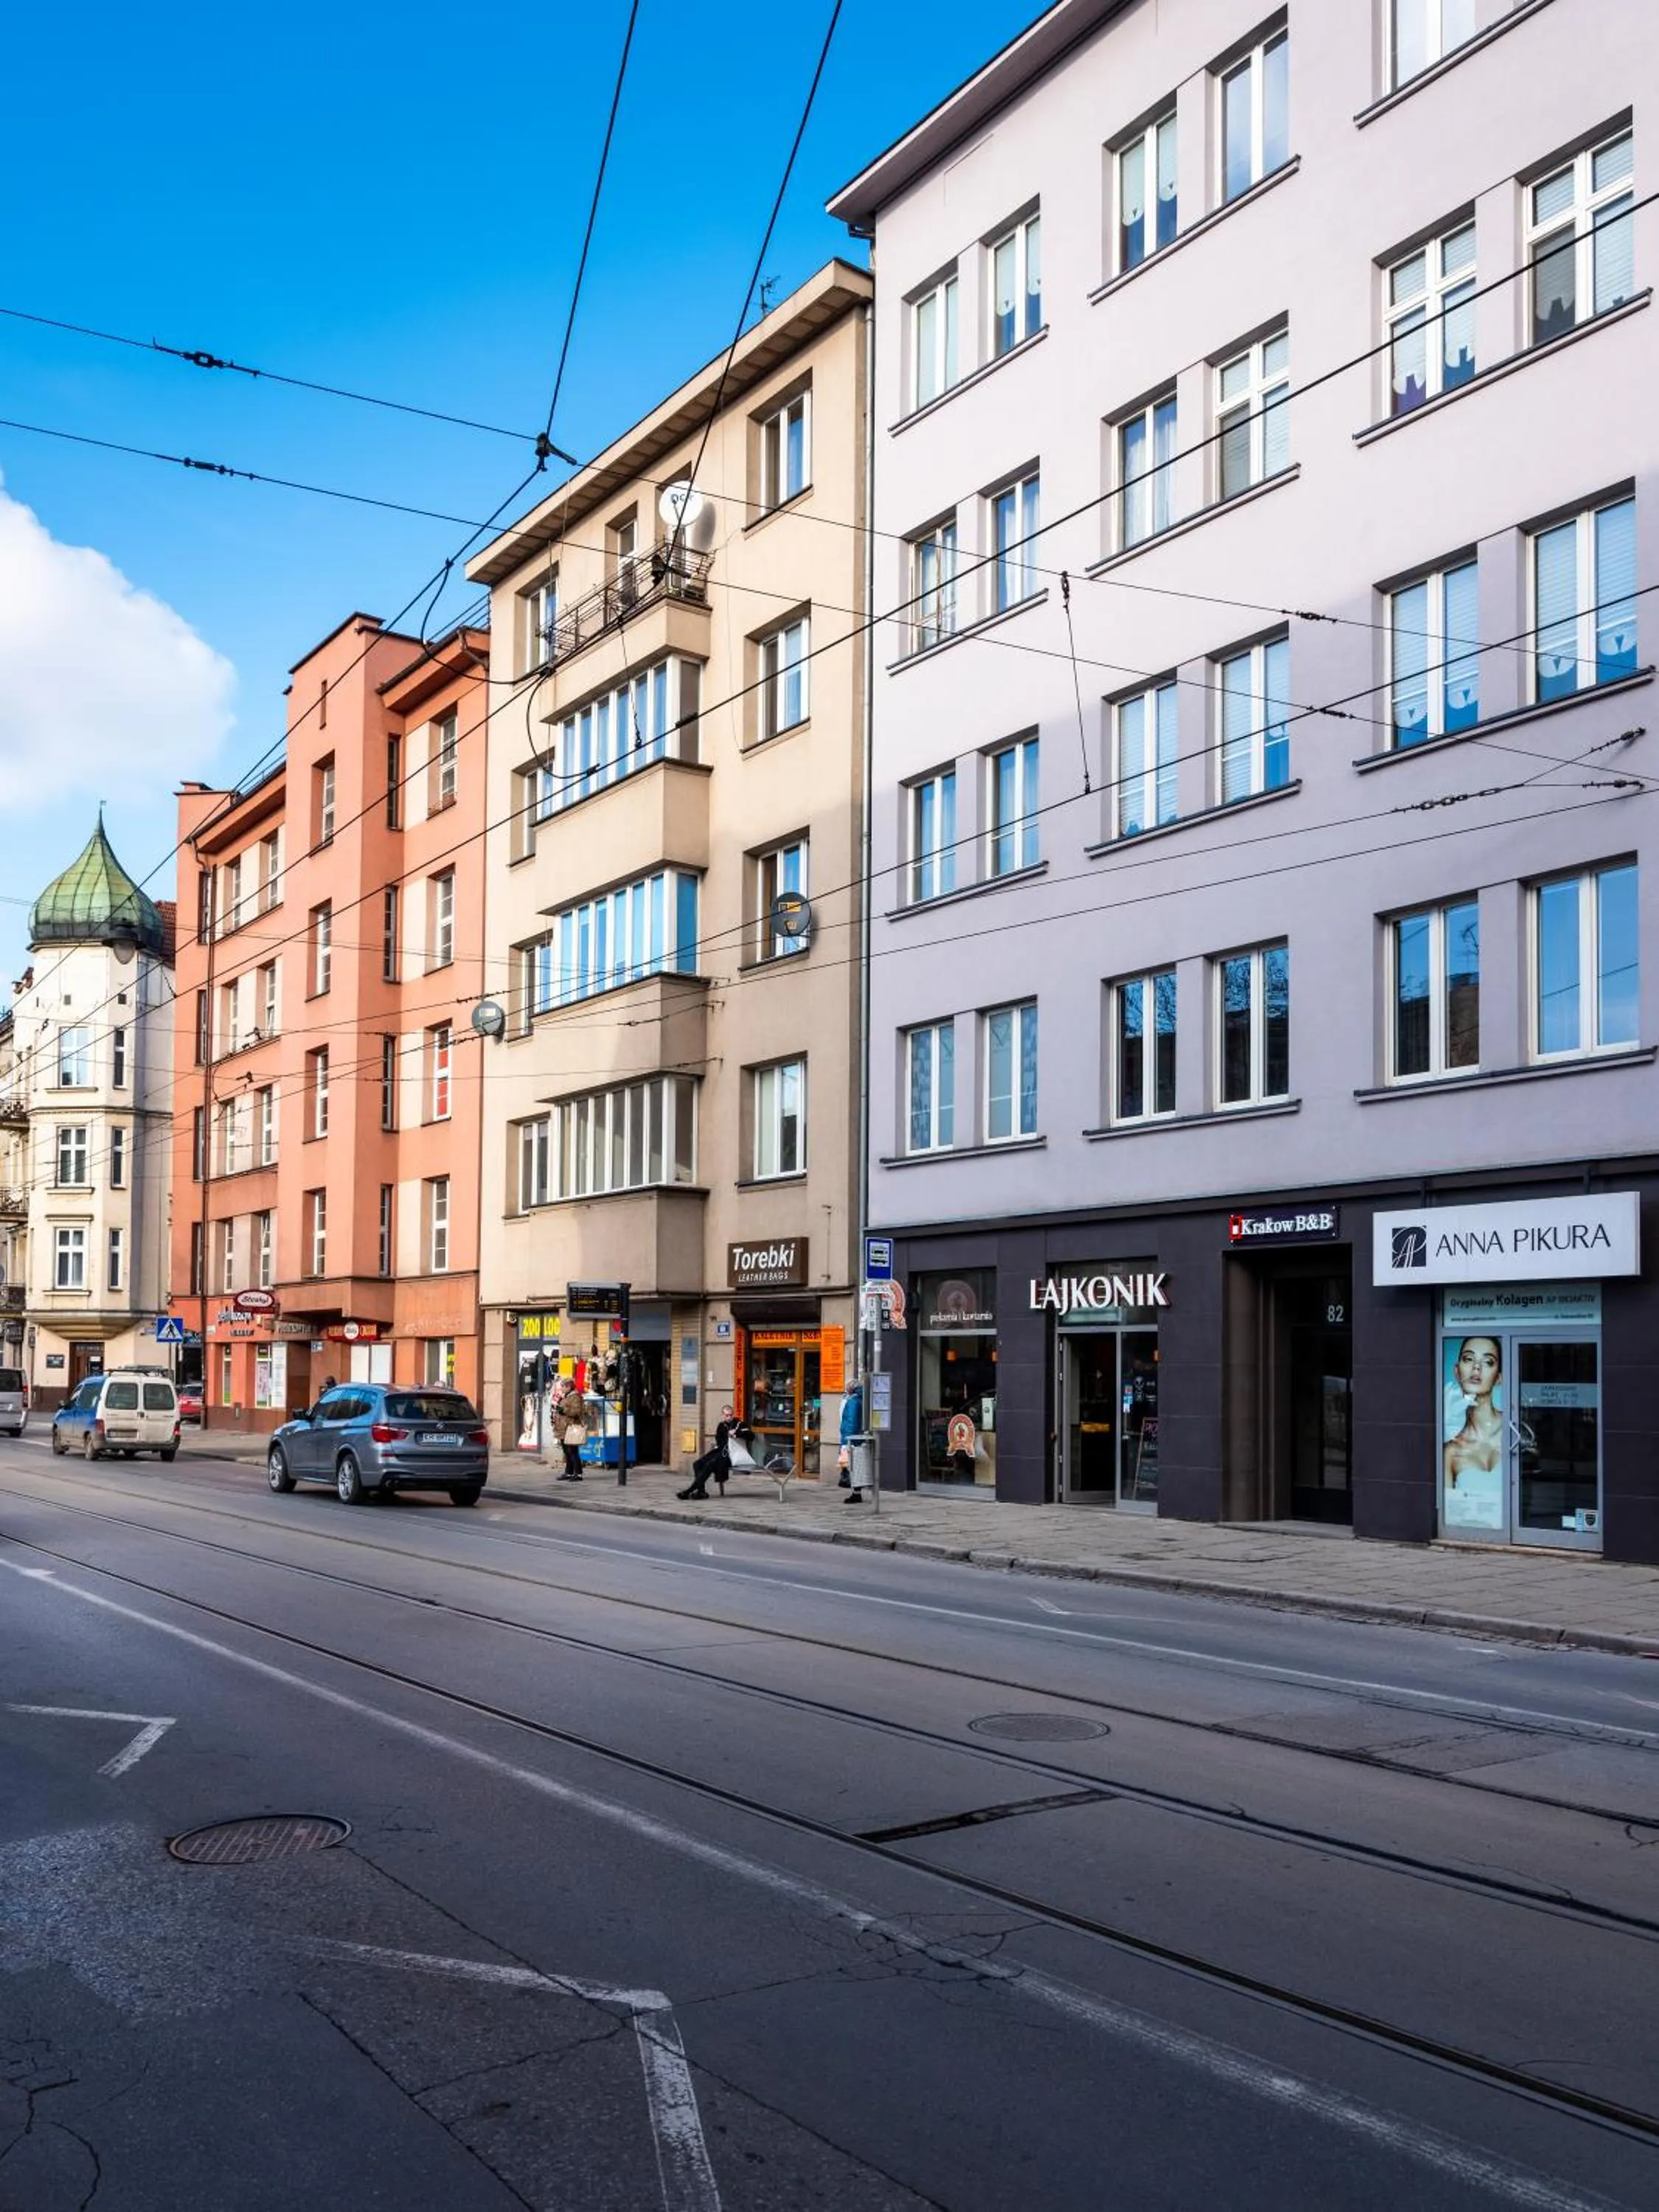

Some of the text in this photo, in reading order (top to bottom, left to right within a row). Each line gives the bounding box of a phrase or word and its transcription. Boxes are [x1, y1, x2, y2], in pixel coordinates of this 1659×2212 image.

[1241, 1213, 1333, 1235] Krakow B&B
[1436, 1230, 1505, 1257] ANNA
[1514, 1223, 1611, 1253] PIKURA
[732, 1242, 796, 1271] Torebki
[738, 1270, 788, 1282] LEATHER BAGS
[1030, 1273, 1170, 1316] LAJKONIK
[1495, 1293, 1543, 1307] Kolagen
[1327, 1304, 1344, 1322] 82
